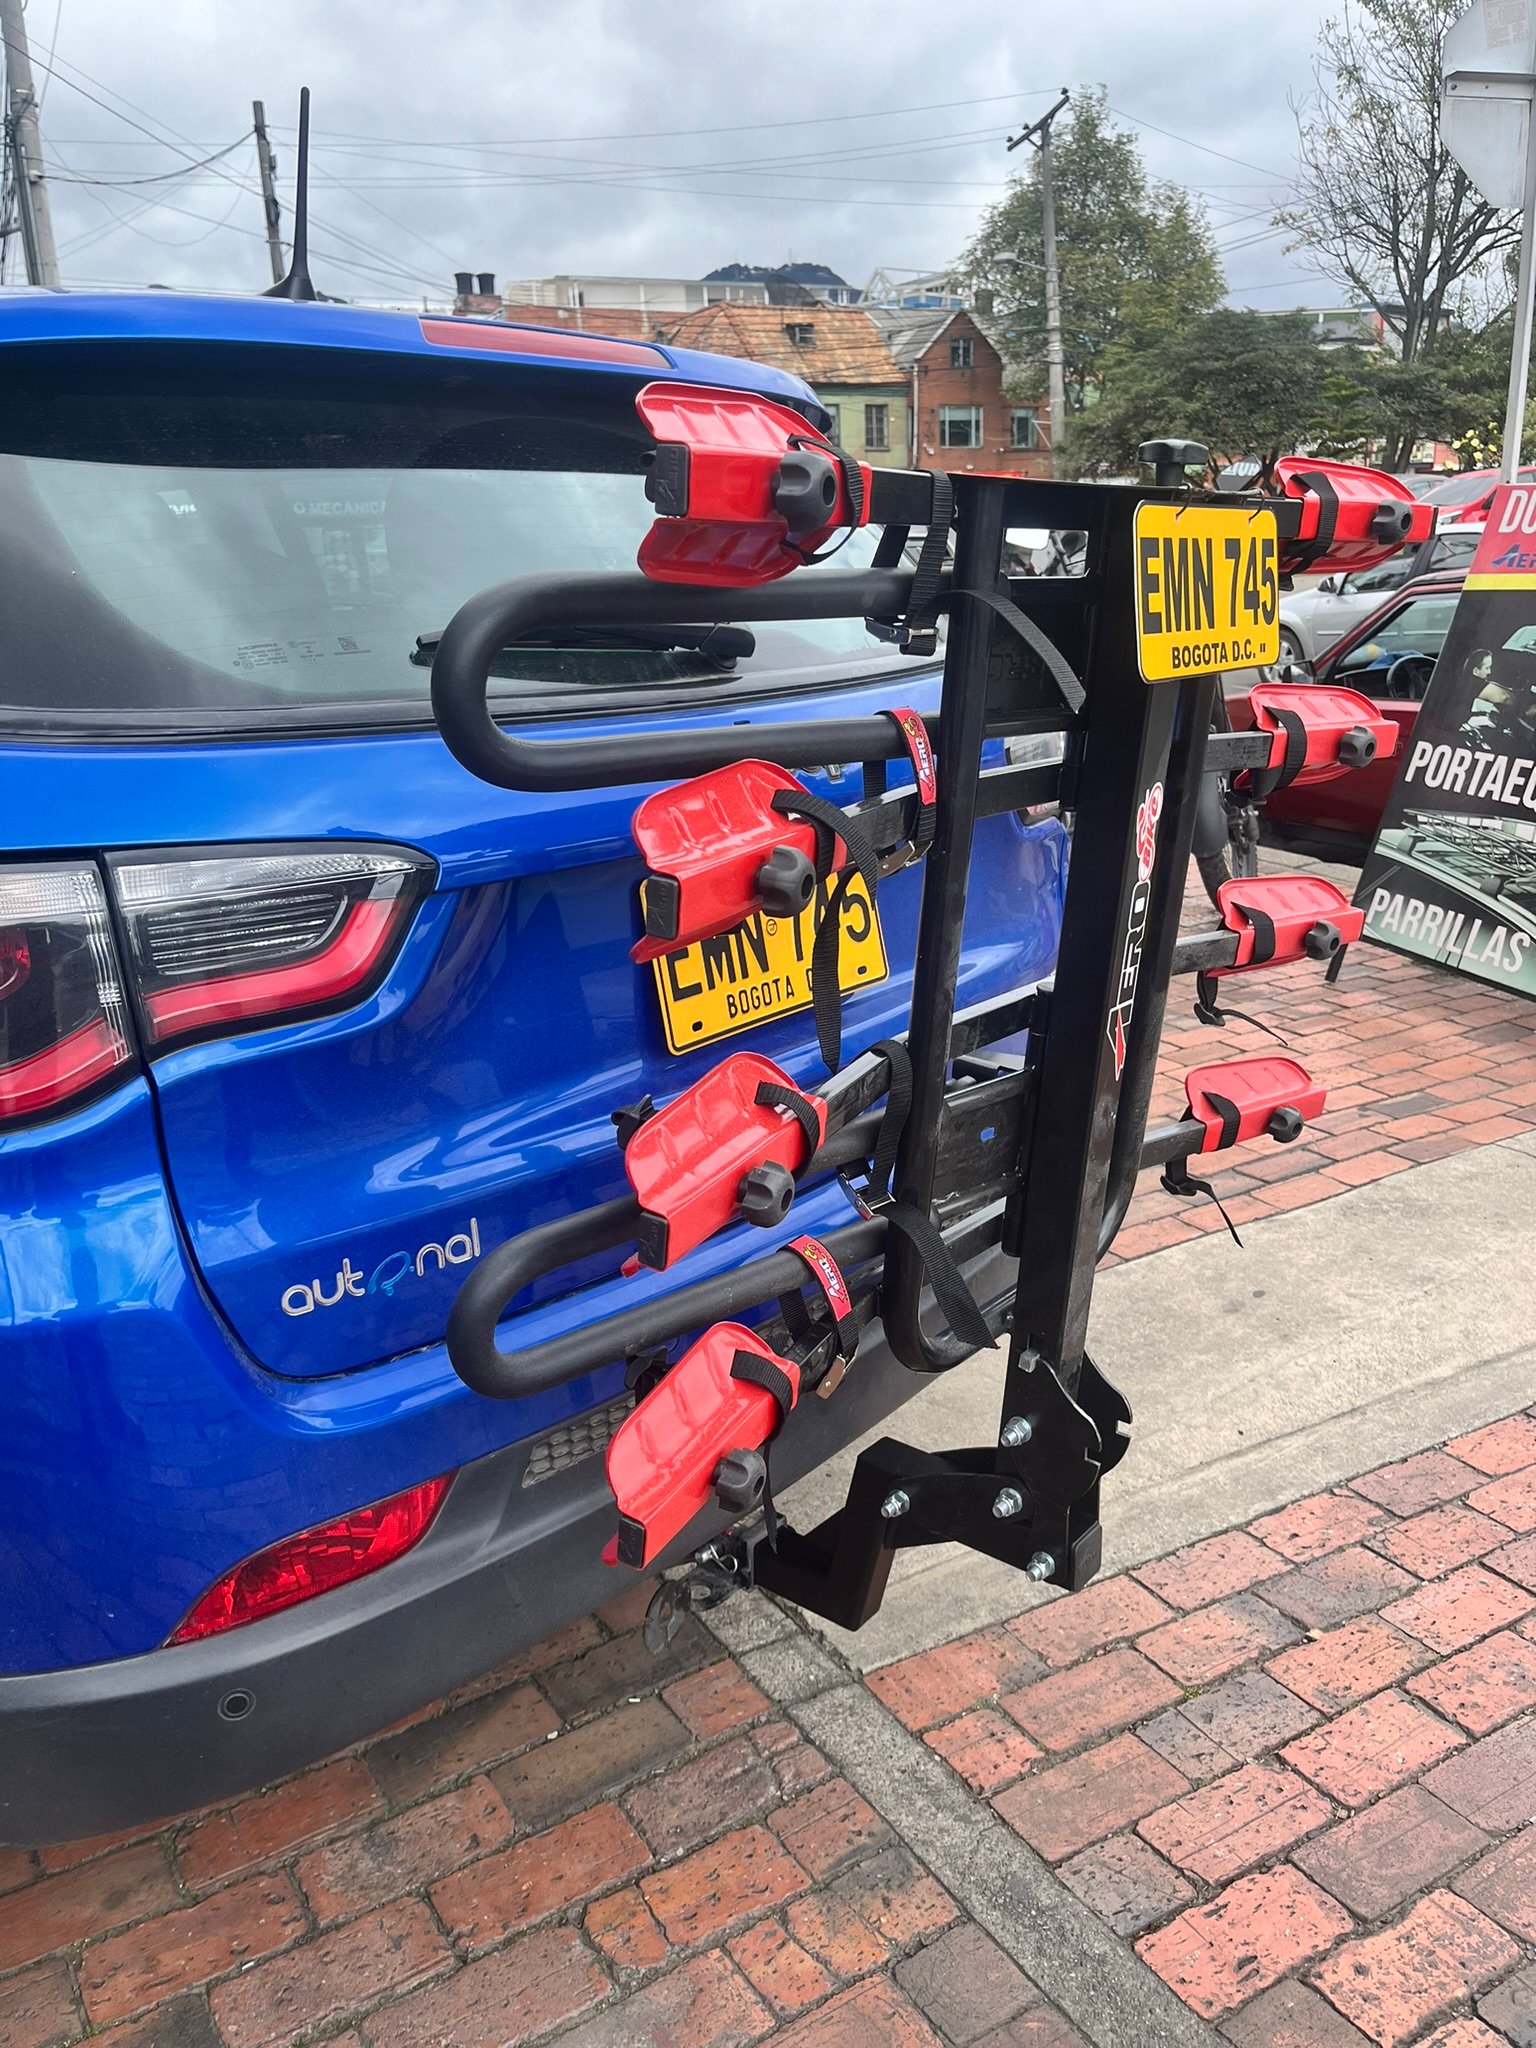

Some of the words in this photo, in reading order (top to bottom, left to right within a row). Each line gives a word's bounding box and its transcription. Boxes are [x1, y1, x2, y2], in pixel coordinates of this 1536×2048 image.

[1140, 537, 1215, 635] EMN
[1224, 536, 1277, 626] 745
[1171, 641, 1229, 669] BOGOTA
[1232, 638, 1256, 662] D.C.
[1365, 887, 1531, 974] PARRILLAS
[726, 975, 795, 1020] BOGOTA
[1106, 880, 1151, 1081] AERO
